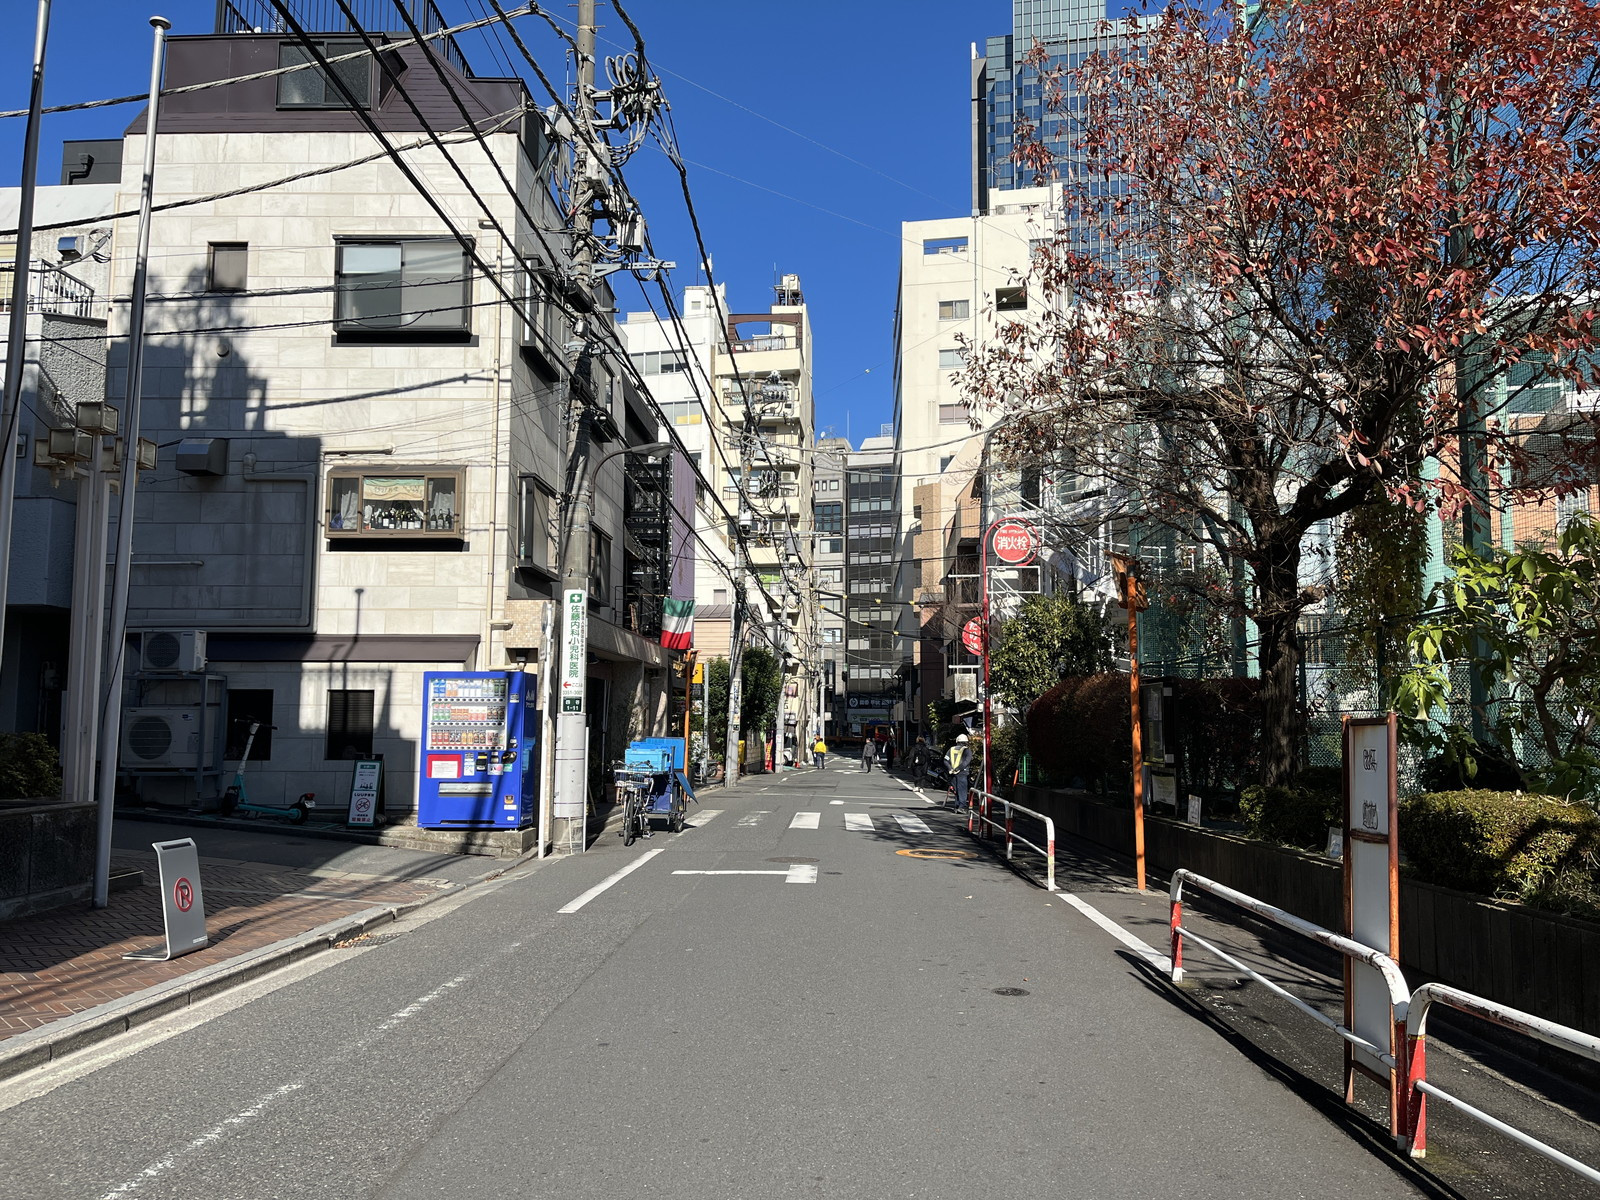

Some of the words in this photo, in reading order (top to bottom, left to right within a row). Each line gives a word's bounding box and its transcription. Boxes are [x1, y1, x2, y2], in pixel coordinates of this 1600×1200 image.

[997, 535, 1028, 550] 消火栓
[569, 604, 580, 678] 佐藤内科小児科医院
